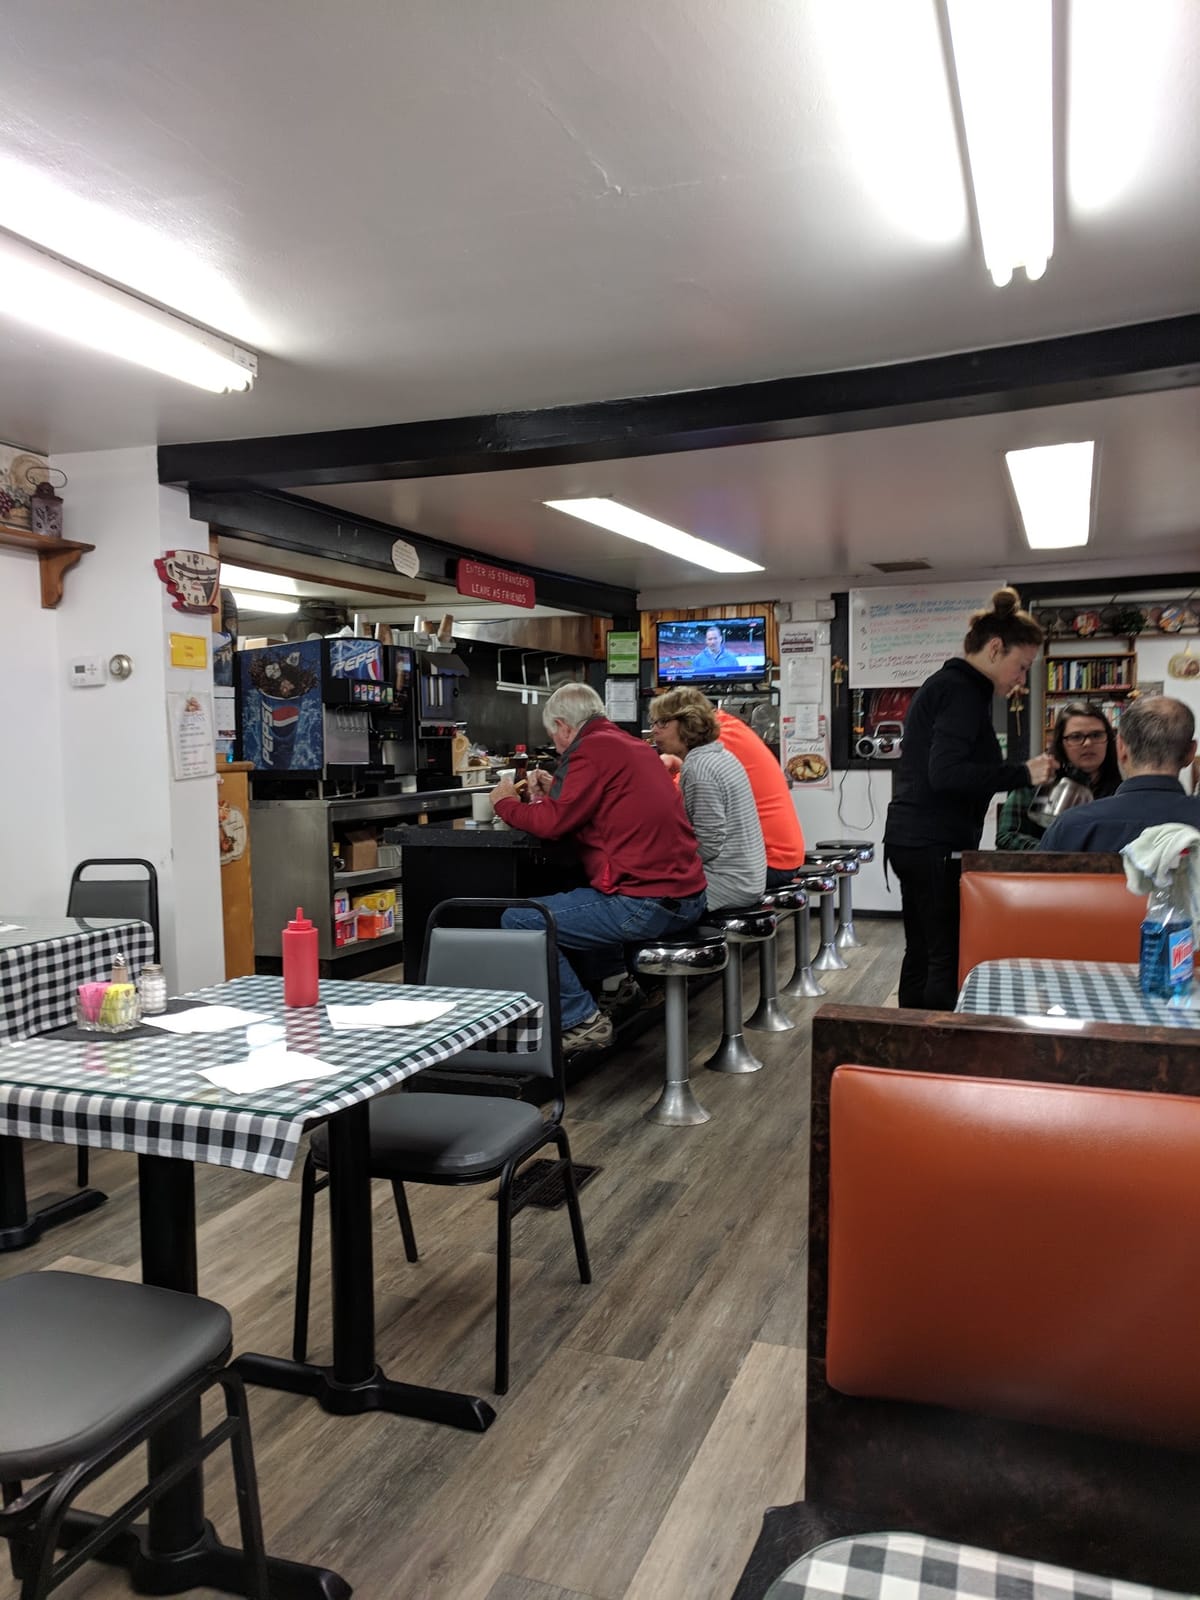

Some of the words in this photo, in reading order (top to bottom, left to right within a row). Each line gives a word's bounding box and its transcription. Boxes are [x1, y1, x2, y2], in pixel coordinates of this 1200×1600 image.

[465, 563, 487, 577] ENTER
[497, 572, 529, 588] STRANGERS
[471, 583, 491, 597] LEAVE
[492, 588, 501, 599] AS
[502, 590, 527, 604] FRIENDS
[332, 645, 379, 677] PEPSI
[262, 700, 274, 766] PEPSI
